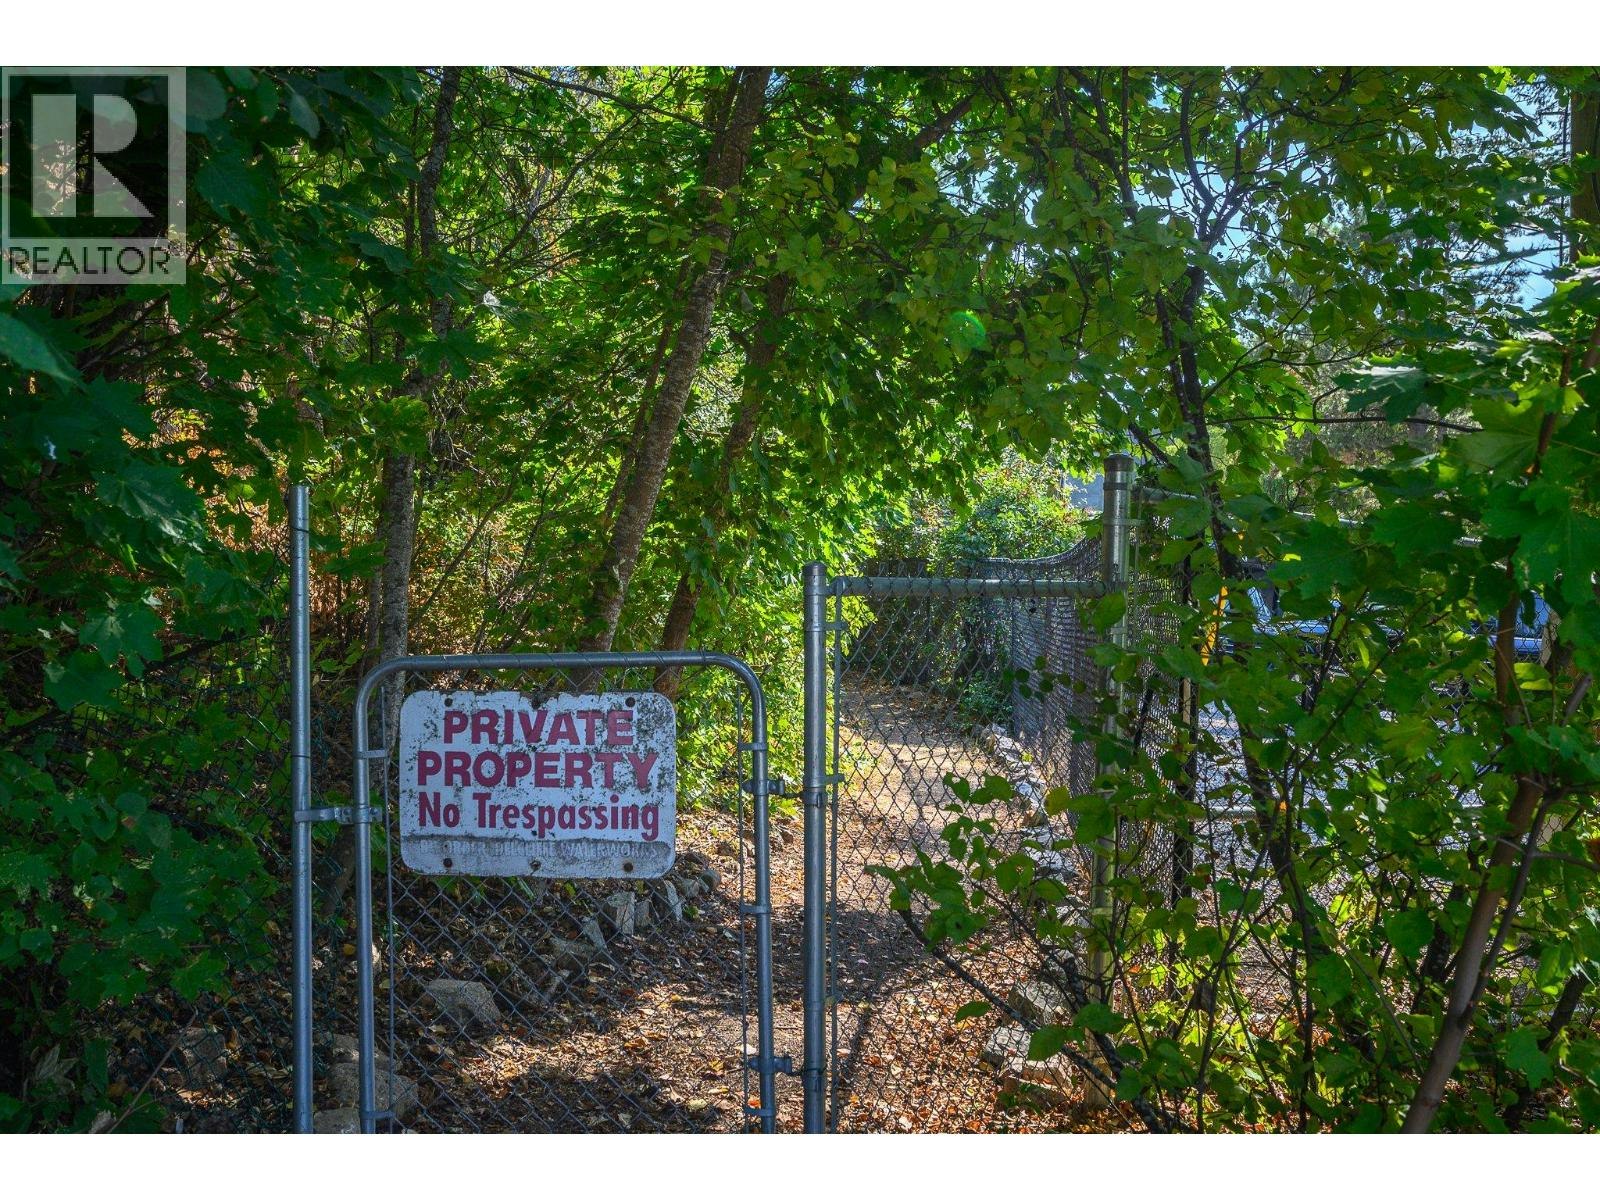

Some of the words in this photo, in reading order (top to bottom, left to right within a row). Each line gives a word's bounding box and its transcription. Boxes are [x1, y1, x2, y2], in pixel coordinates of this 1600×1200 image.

[443, 709, 633, 745] PRIVATE
[417, 751, 658, 789] PROPERTY
[418, 791, 460, 827] No
[472, 792, 659, 841] Trespassing
